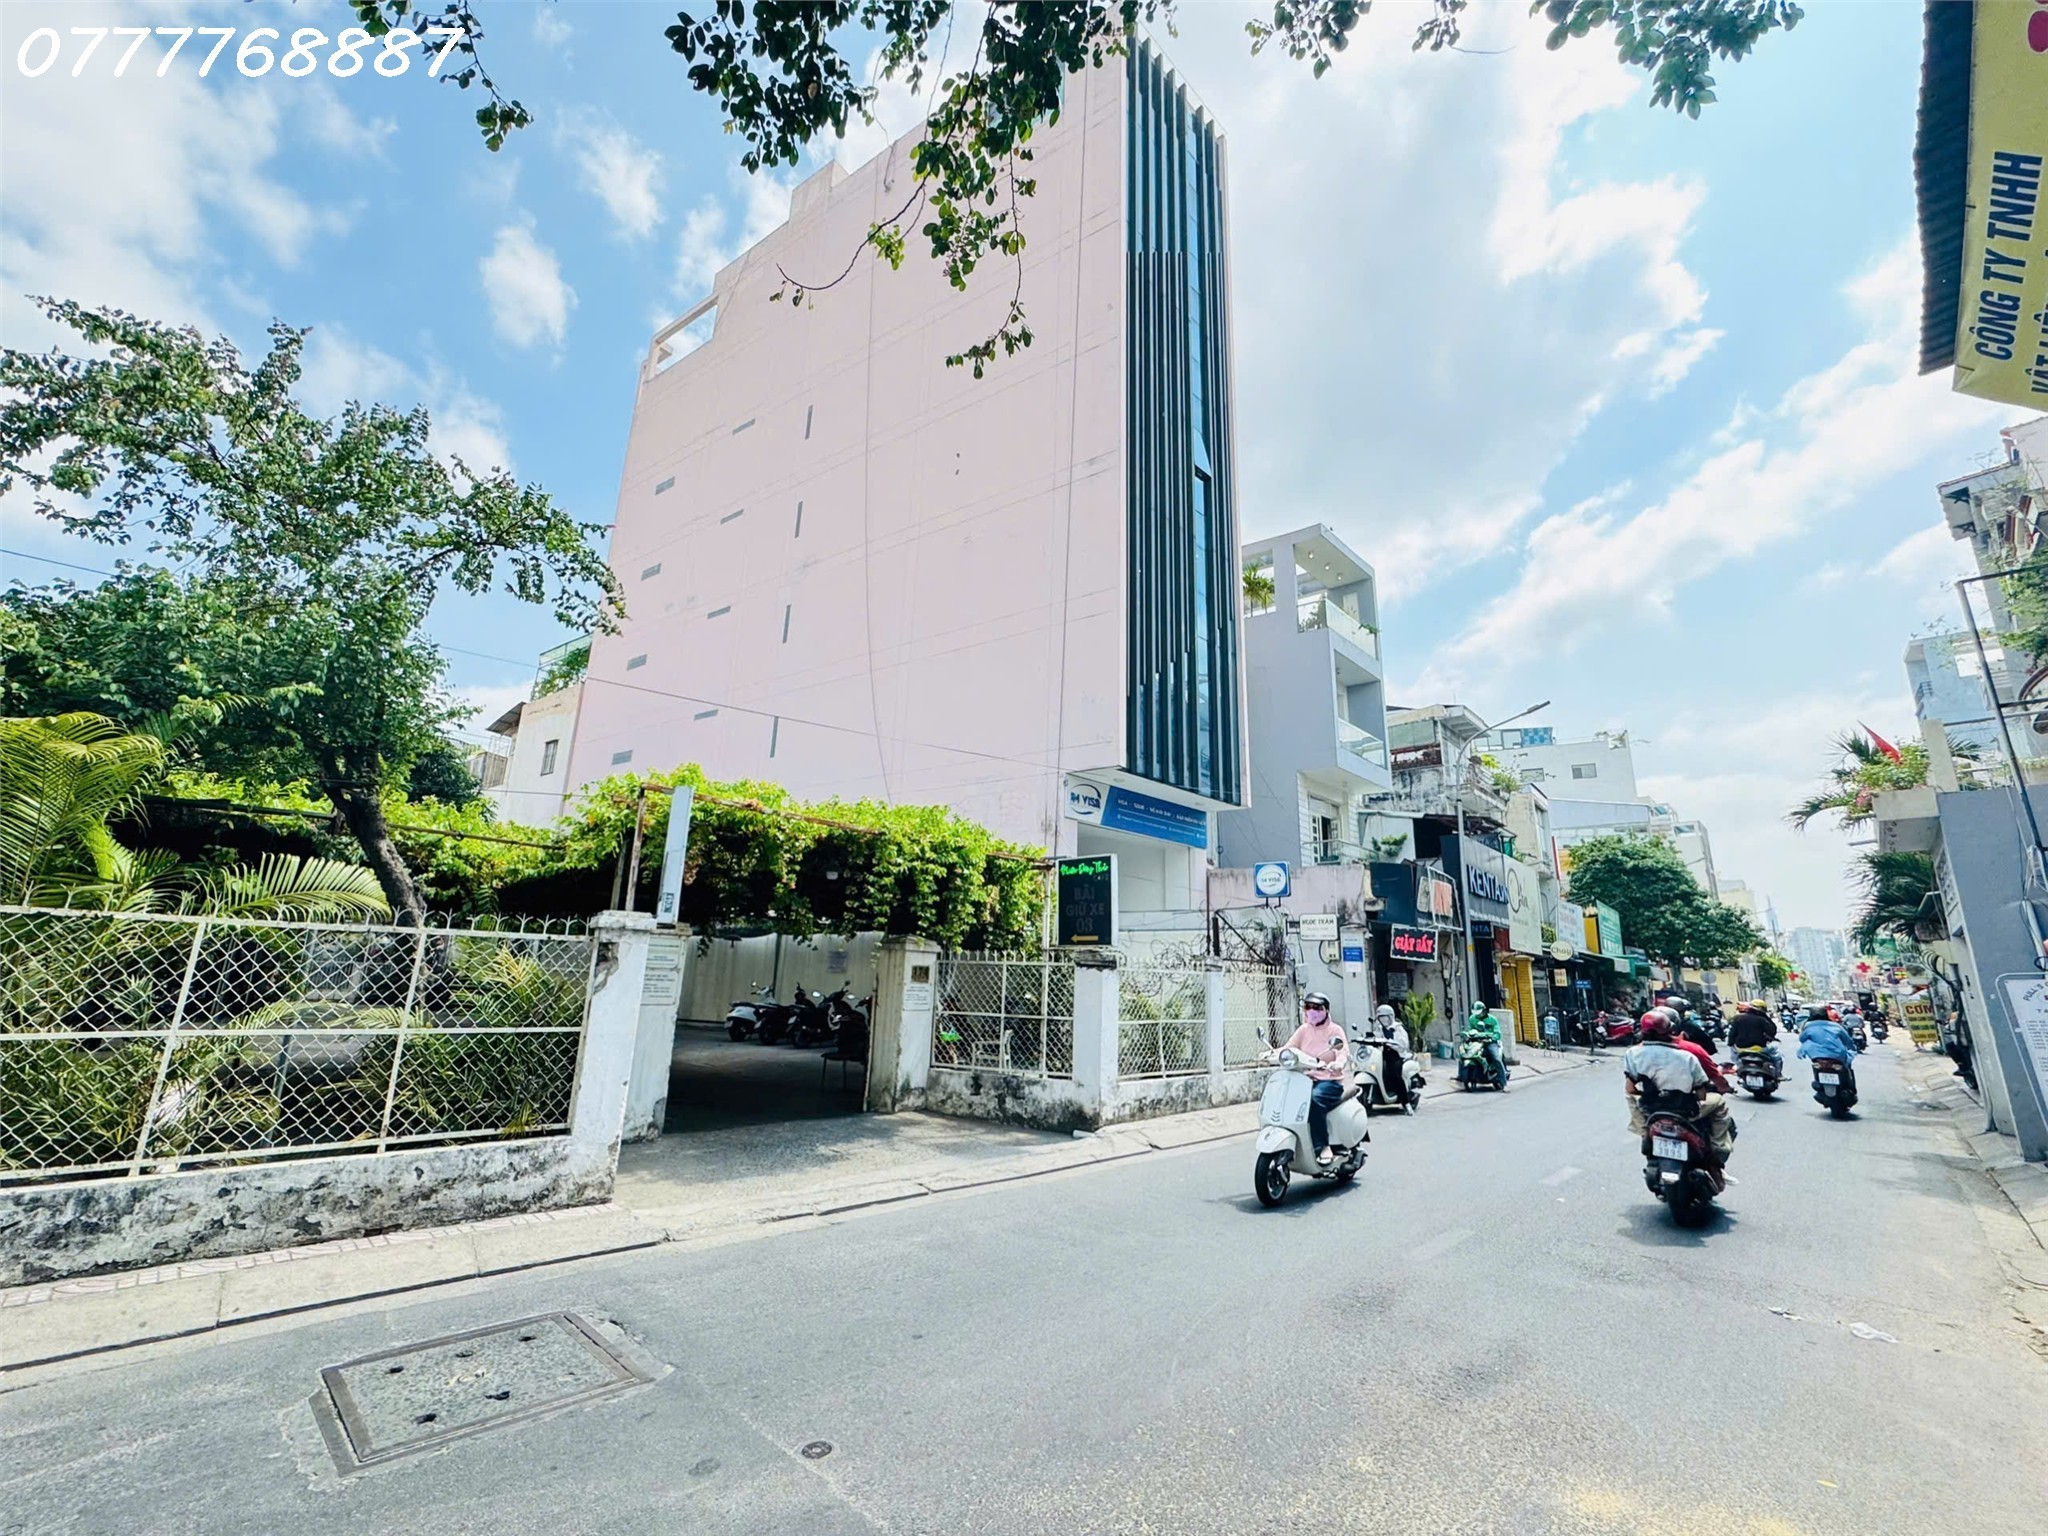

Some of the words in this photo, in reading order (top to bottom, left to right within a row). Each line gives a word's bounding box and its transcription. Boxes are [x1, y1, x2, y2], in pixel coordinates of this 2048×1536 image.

[1987, 151, 2043, 241] TNHH
[1983, 247, 2026, 284] TY
[1969, 290, 2020, 361] CÔNG
[1089, 902, 1105, 916] XE
